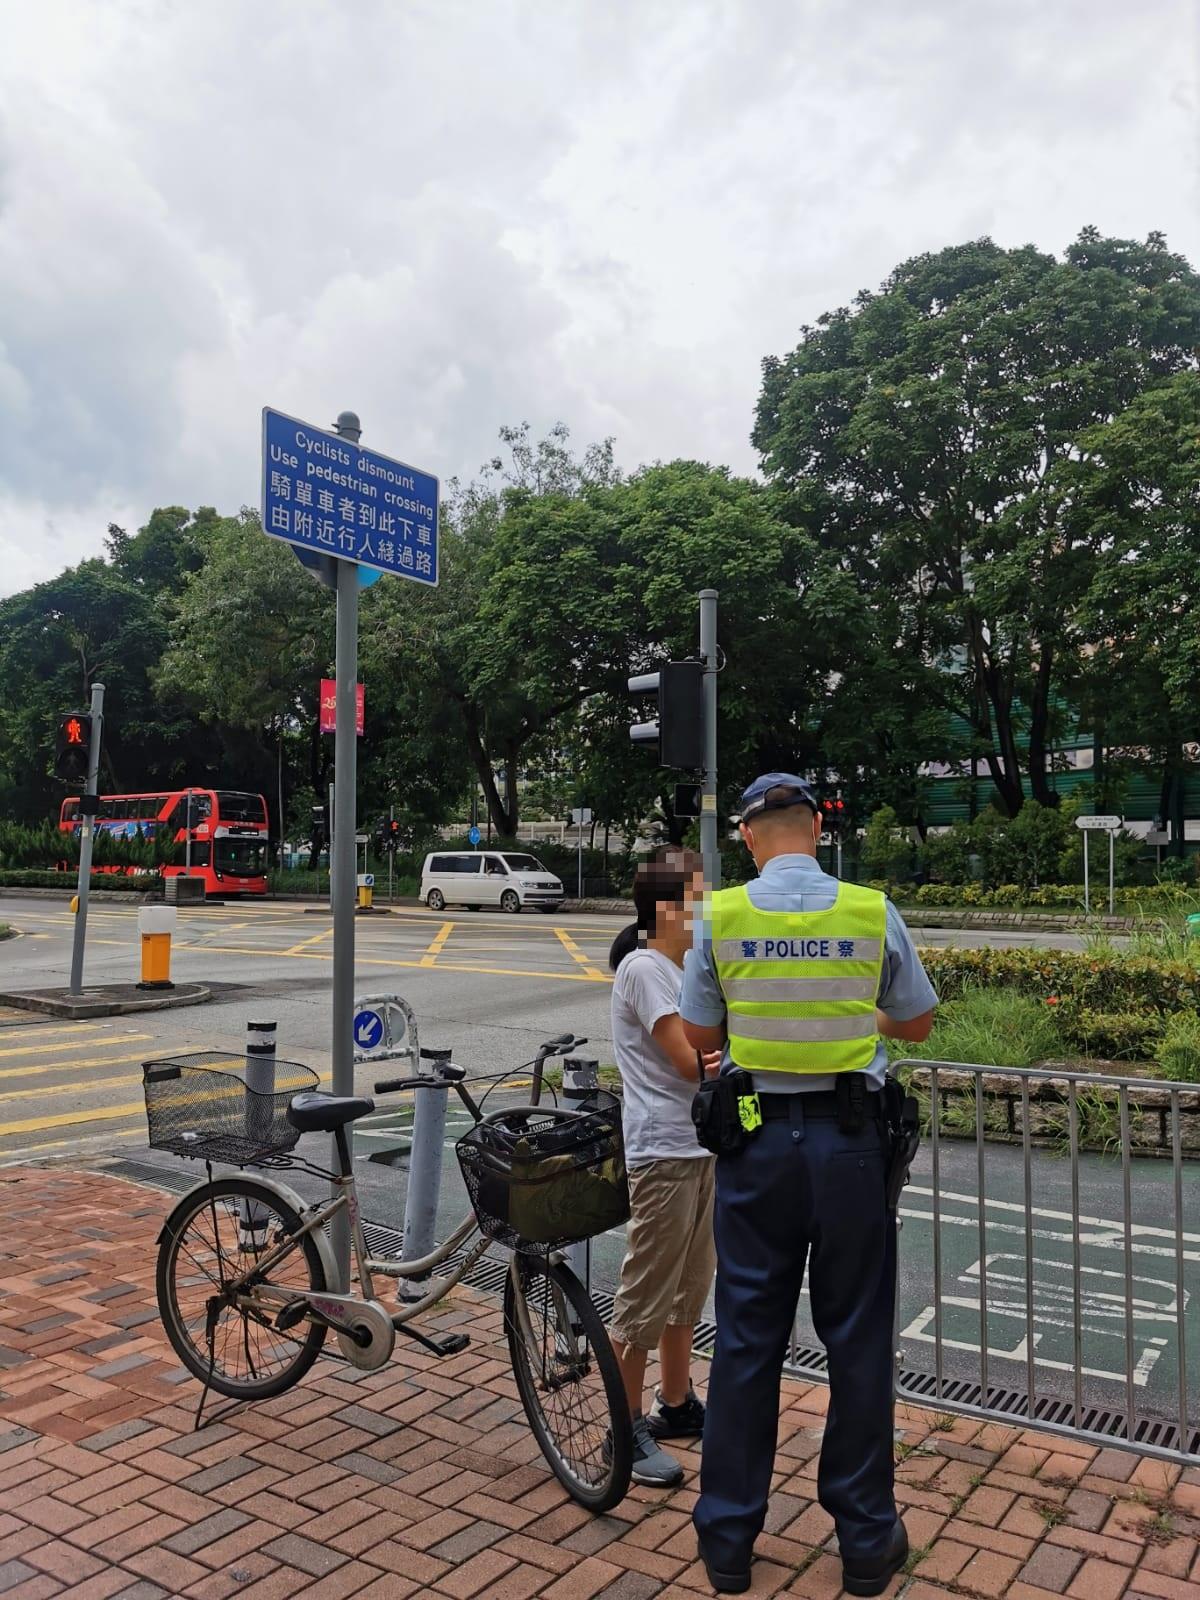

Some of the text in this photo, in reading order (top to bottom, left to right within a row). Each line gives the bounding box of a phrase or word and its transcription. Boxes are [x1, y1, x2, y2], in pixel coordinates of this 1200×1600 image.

[270, 444, 433, 520] Use pedestrian crossing
[295, 431, 415, 491] Cyclists dismount
[270, 470, 432, 546] 騎單車者到此下車
[271, 504, 432, 575] 由附近行人綫過路
[741, 940, 854, 958] 警 POLICE 察
